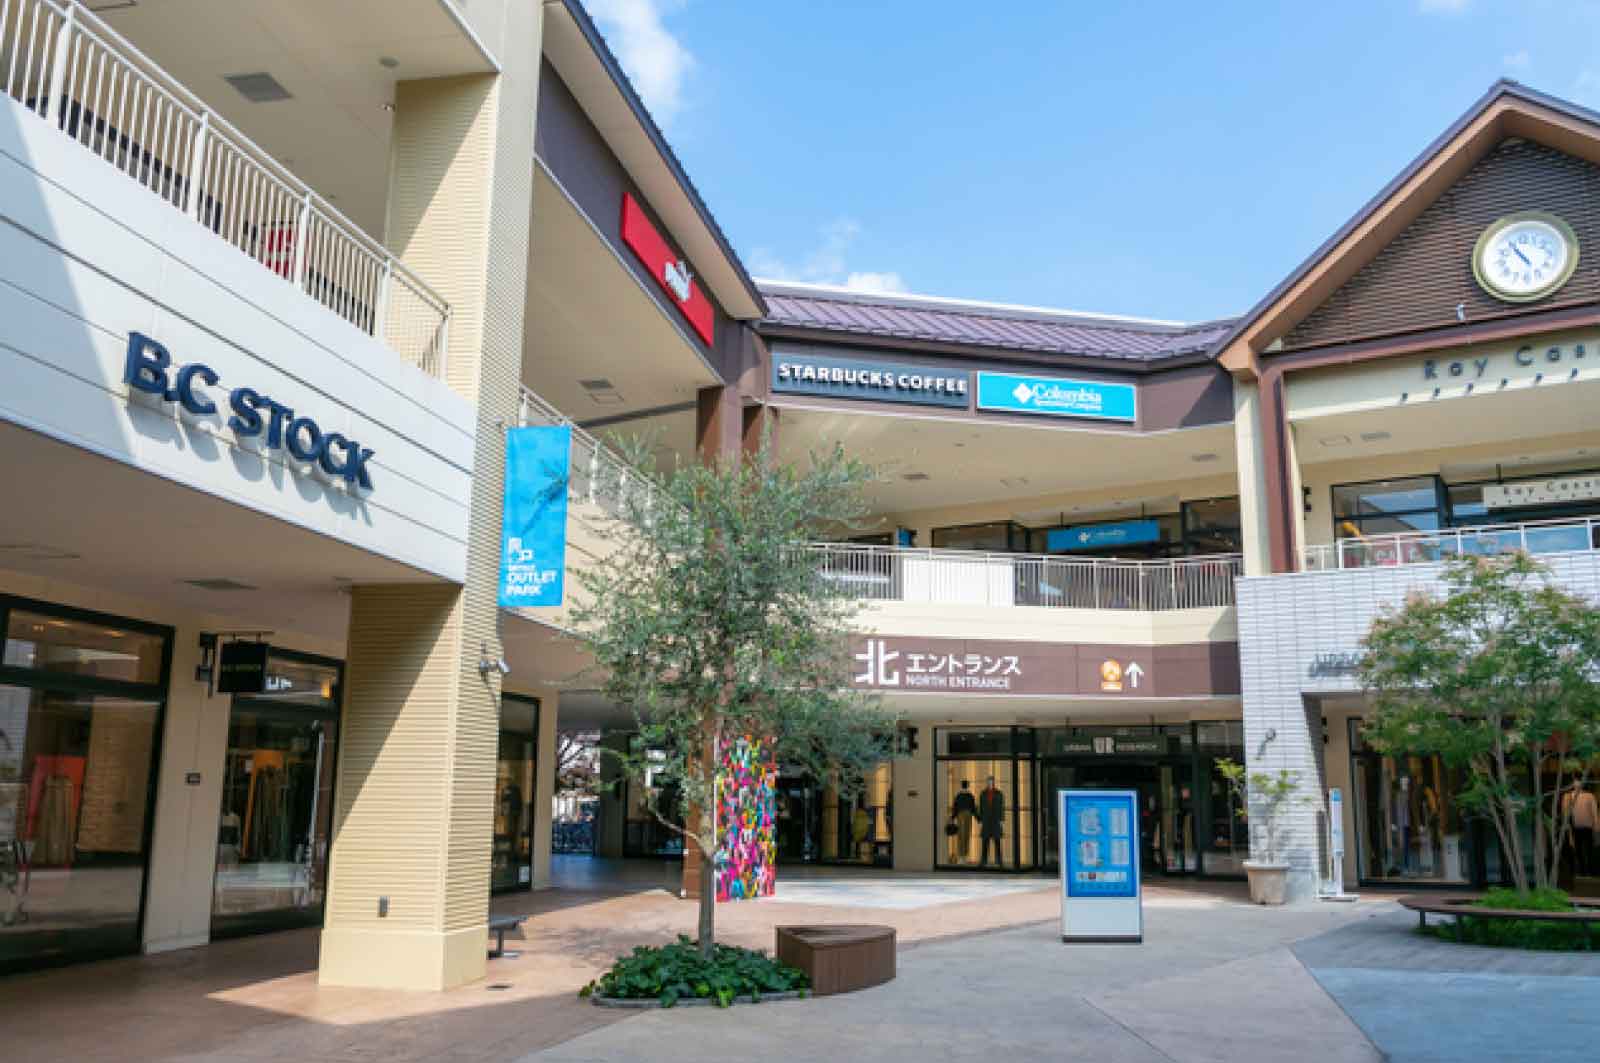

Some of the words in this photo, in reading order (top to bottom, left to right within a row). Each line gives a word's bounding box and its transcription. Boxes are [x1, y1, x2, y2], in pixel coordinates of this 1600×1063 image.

[778, 361, 894, 388] STARBUCKS
[897, 374, 968, 394] COFFEE
[1031, 382, 1102, 403] Columbia
[123, 331, 221, 415] B.C
[227, 386, 376, 491] STOCK
[508, 569, 557, 585] OUTLET
[505, 585, 542, 597] PARK
[855, 639, 900, 686] 北
[905, 652, 1022, 676] エントランス
[905, 674, 947, 688] NORTH
[949, 675, 1011, 689] ENTRANCE
